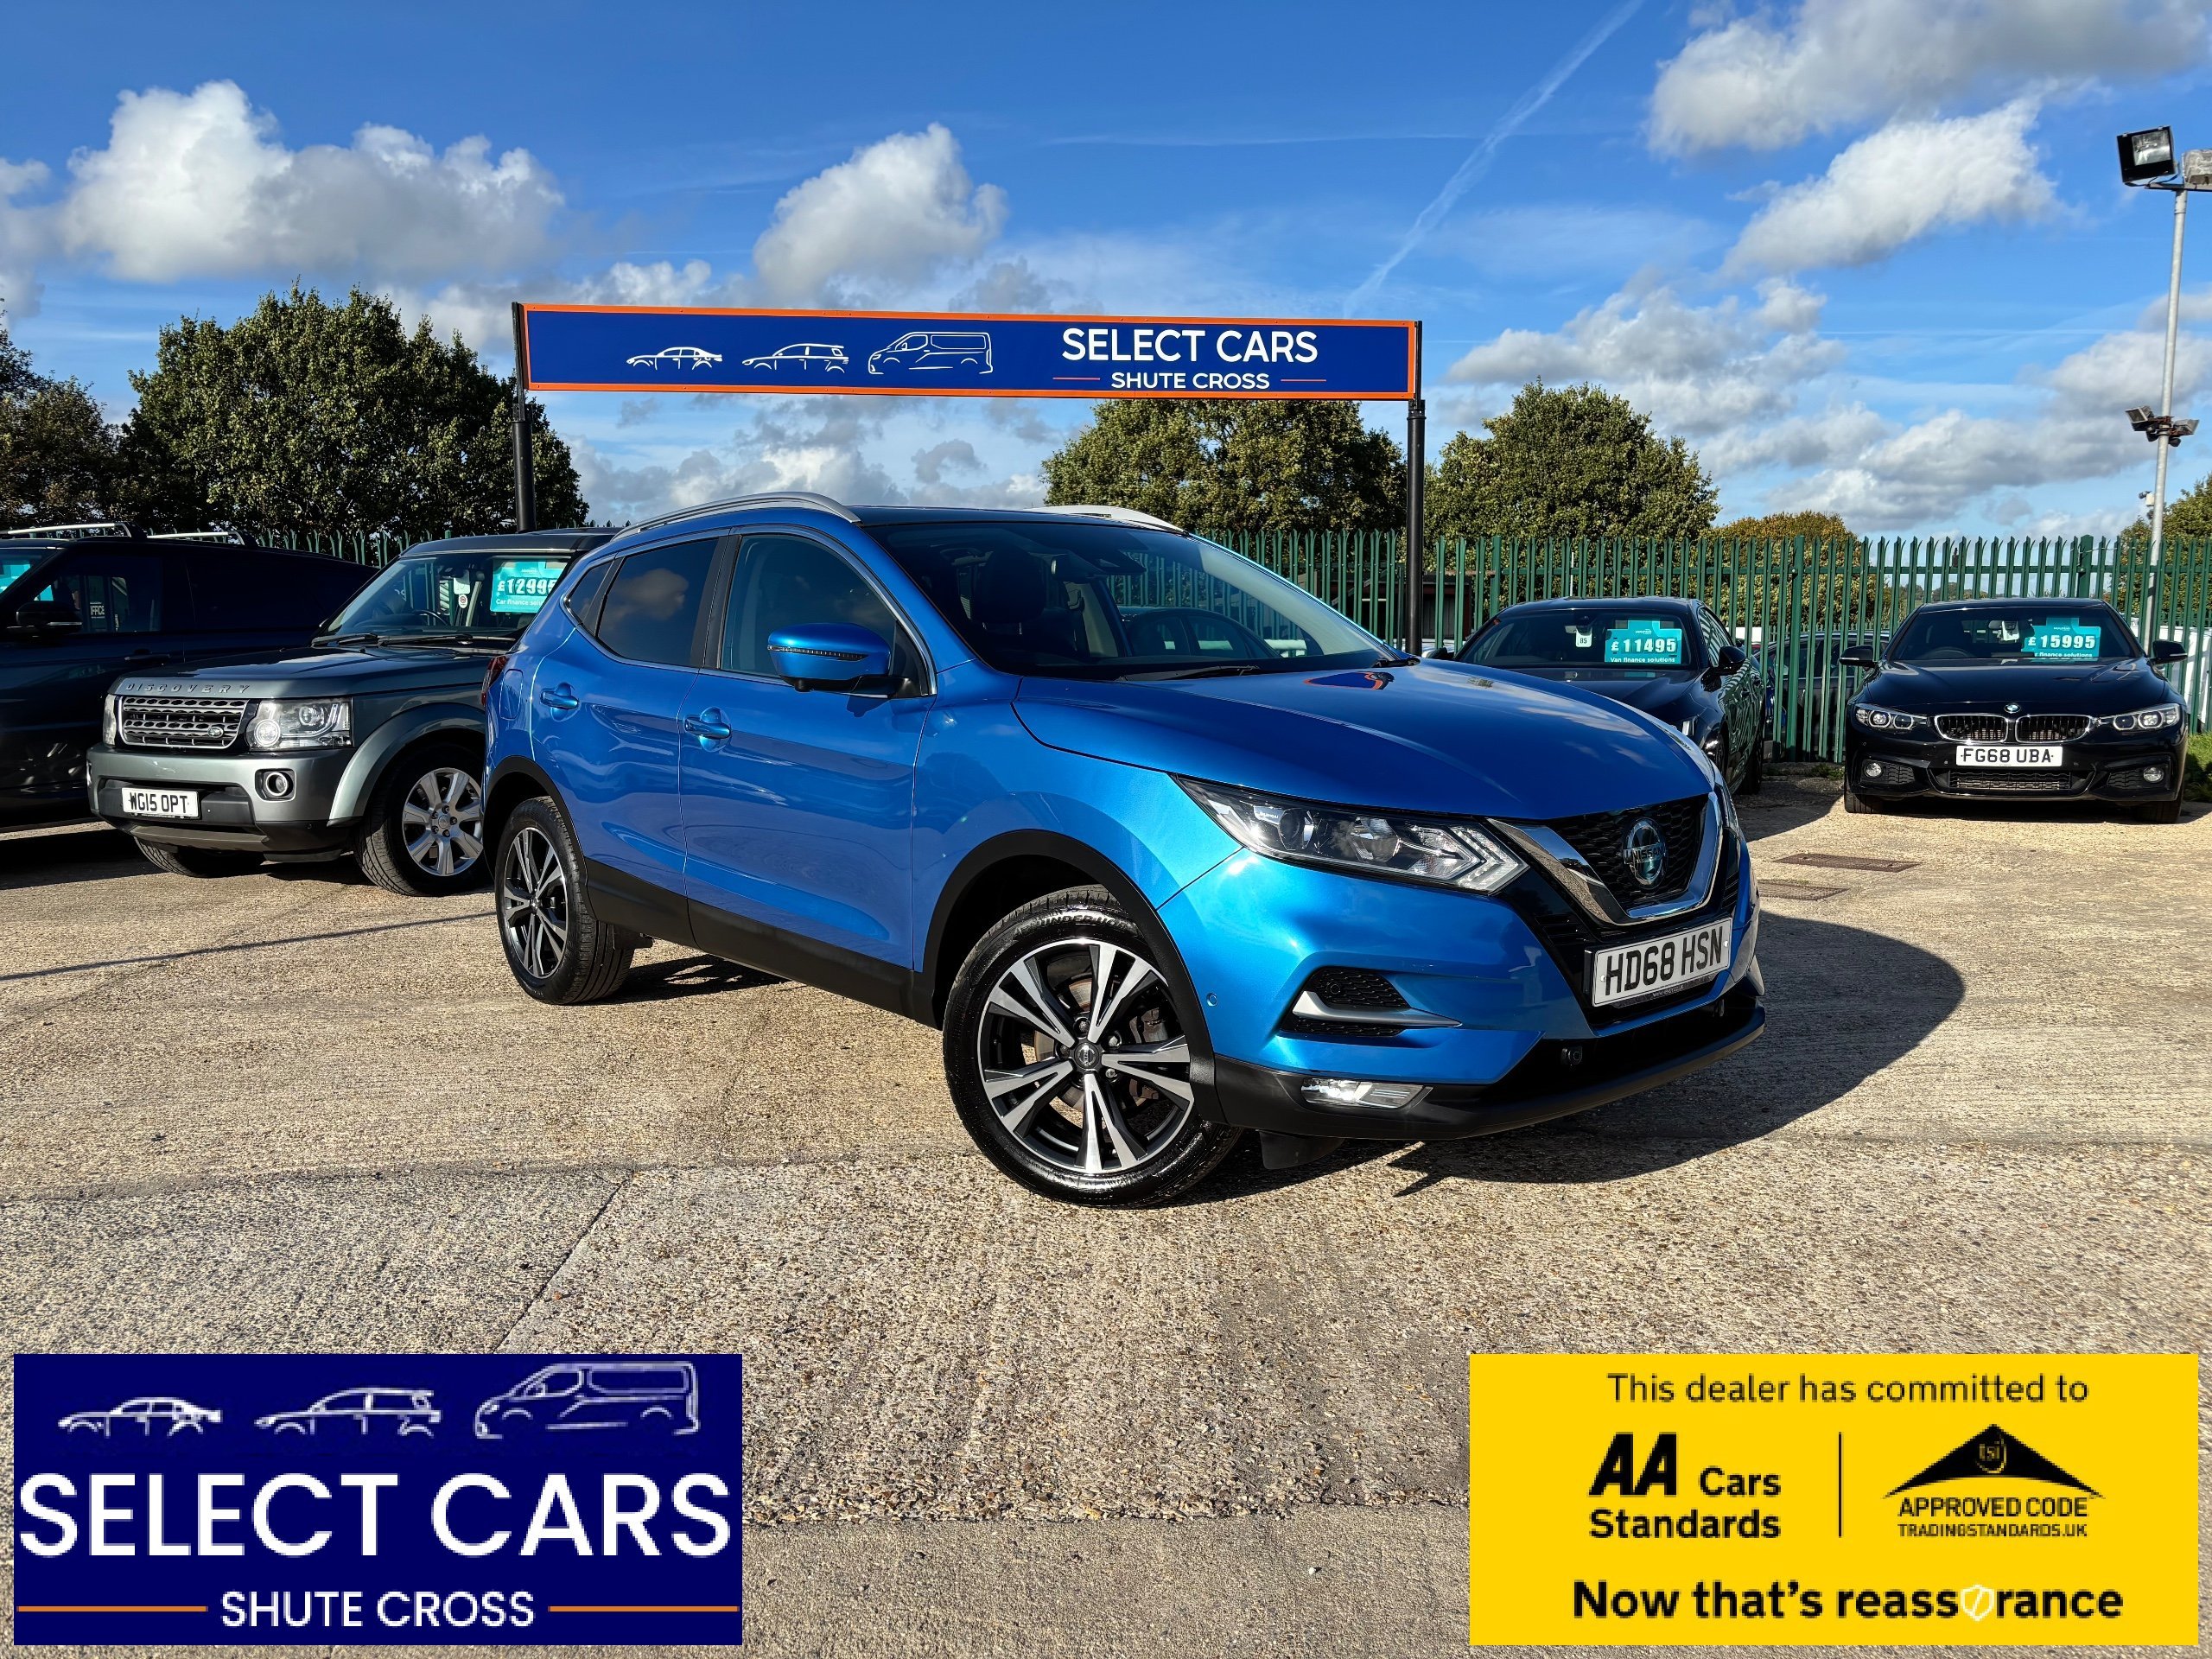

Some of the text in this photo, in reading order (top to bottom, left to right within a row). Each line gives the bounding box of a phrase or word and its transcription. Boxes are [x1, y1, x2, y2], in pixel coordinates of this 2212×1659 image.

[1062, 327, 1319, 362] SELECT CARS
[1111, 372, 1270, 389] SHUTE CROSS
[125, 683, 251, 694] DISCOVERY
[1962, 747, 2051, 763] FG68 UBA
[130, 791, 188, 814] WG15 OPT
[1605, 925, 1724, 995] HD68 HSN
